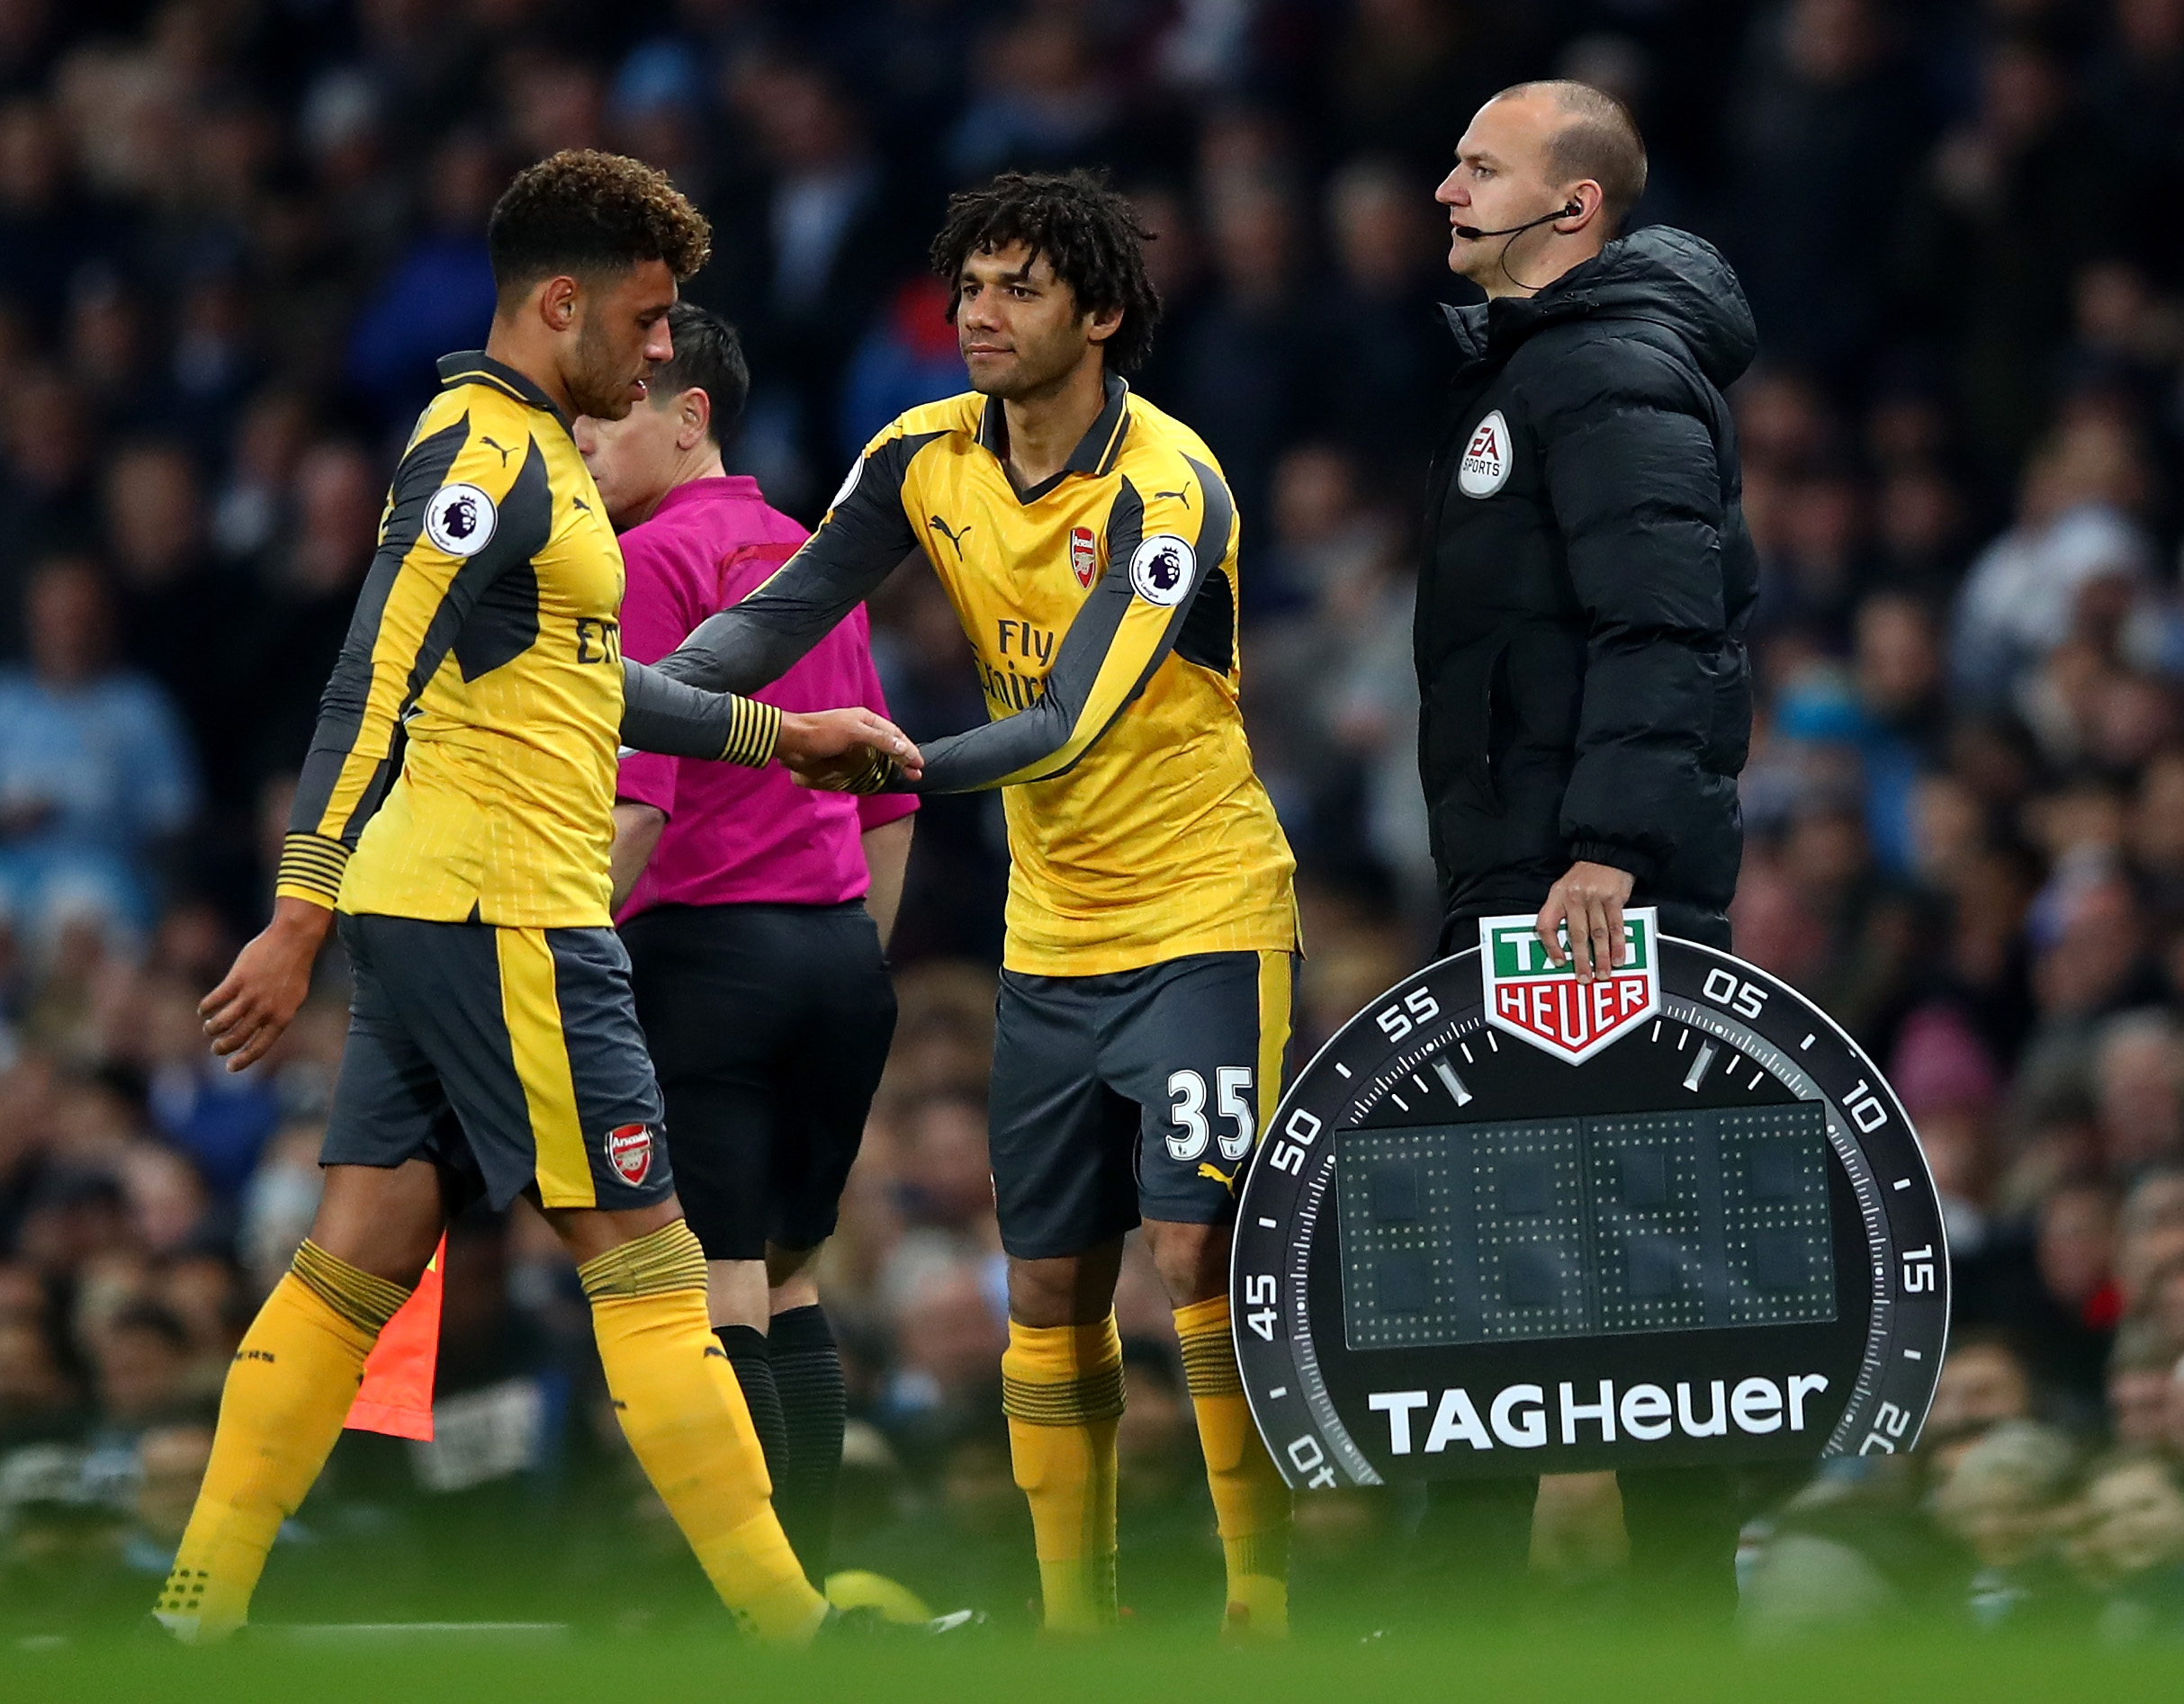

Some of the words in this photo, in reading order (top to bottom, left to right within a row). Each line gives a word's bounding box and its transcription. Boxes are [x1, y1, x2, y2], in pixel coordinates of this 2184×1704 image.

[1463, 457, 1501, 477] SPORTS
[1469, 426, 1500, 461] EA
[997, 619, 1054, 668] Fly
[1375, 985, 1440, 1044] 55
[1500, 979, 1644, 1047] HEUER
[1703, 967, 1769, 1019] 05
[1165, 1065, 1255, 1161] 35
[1842, 1079, 1888, 1134] 10
[1270, 1108, 1322, 1176] 50
[1901, 1244, 1935, 1293] 15
[1245, 1274, 1278, 1341] 45
